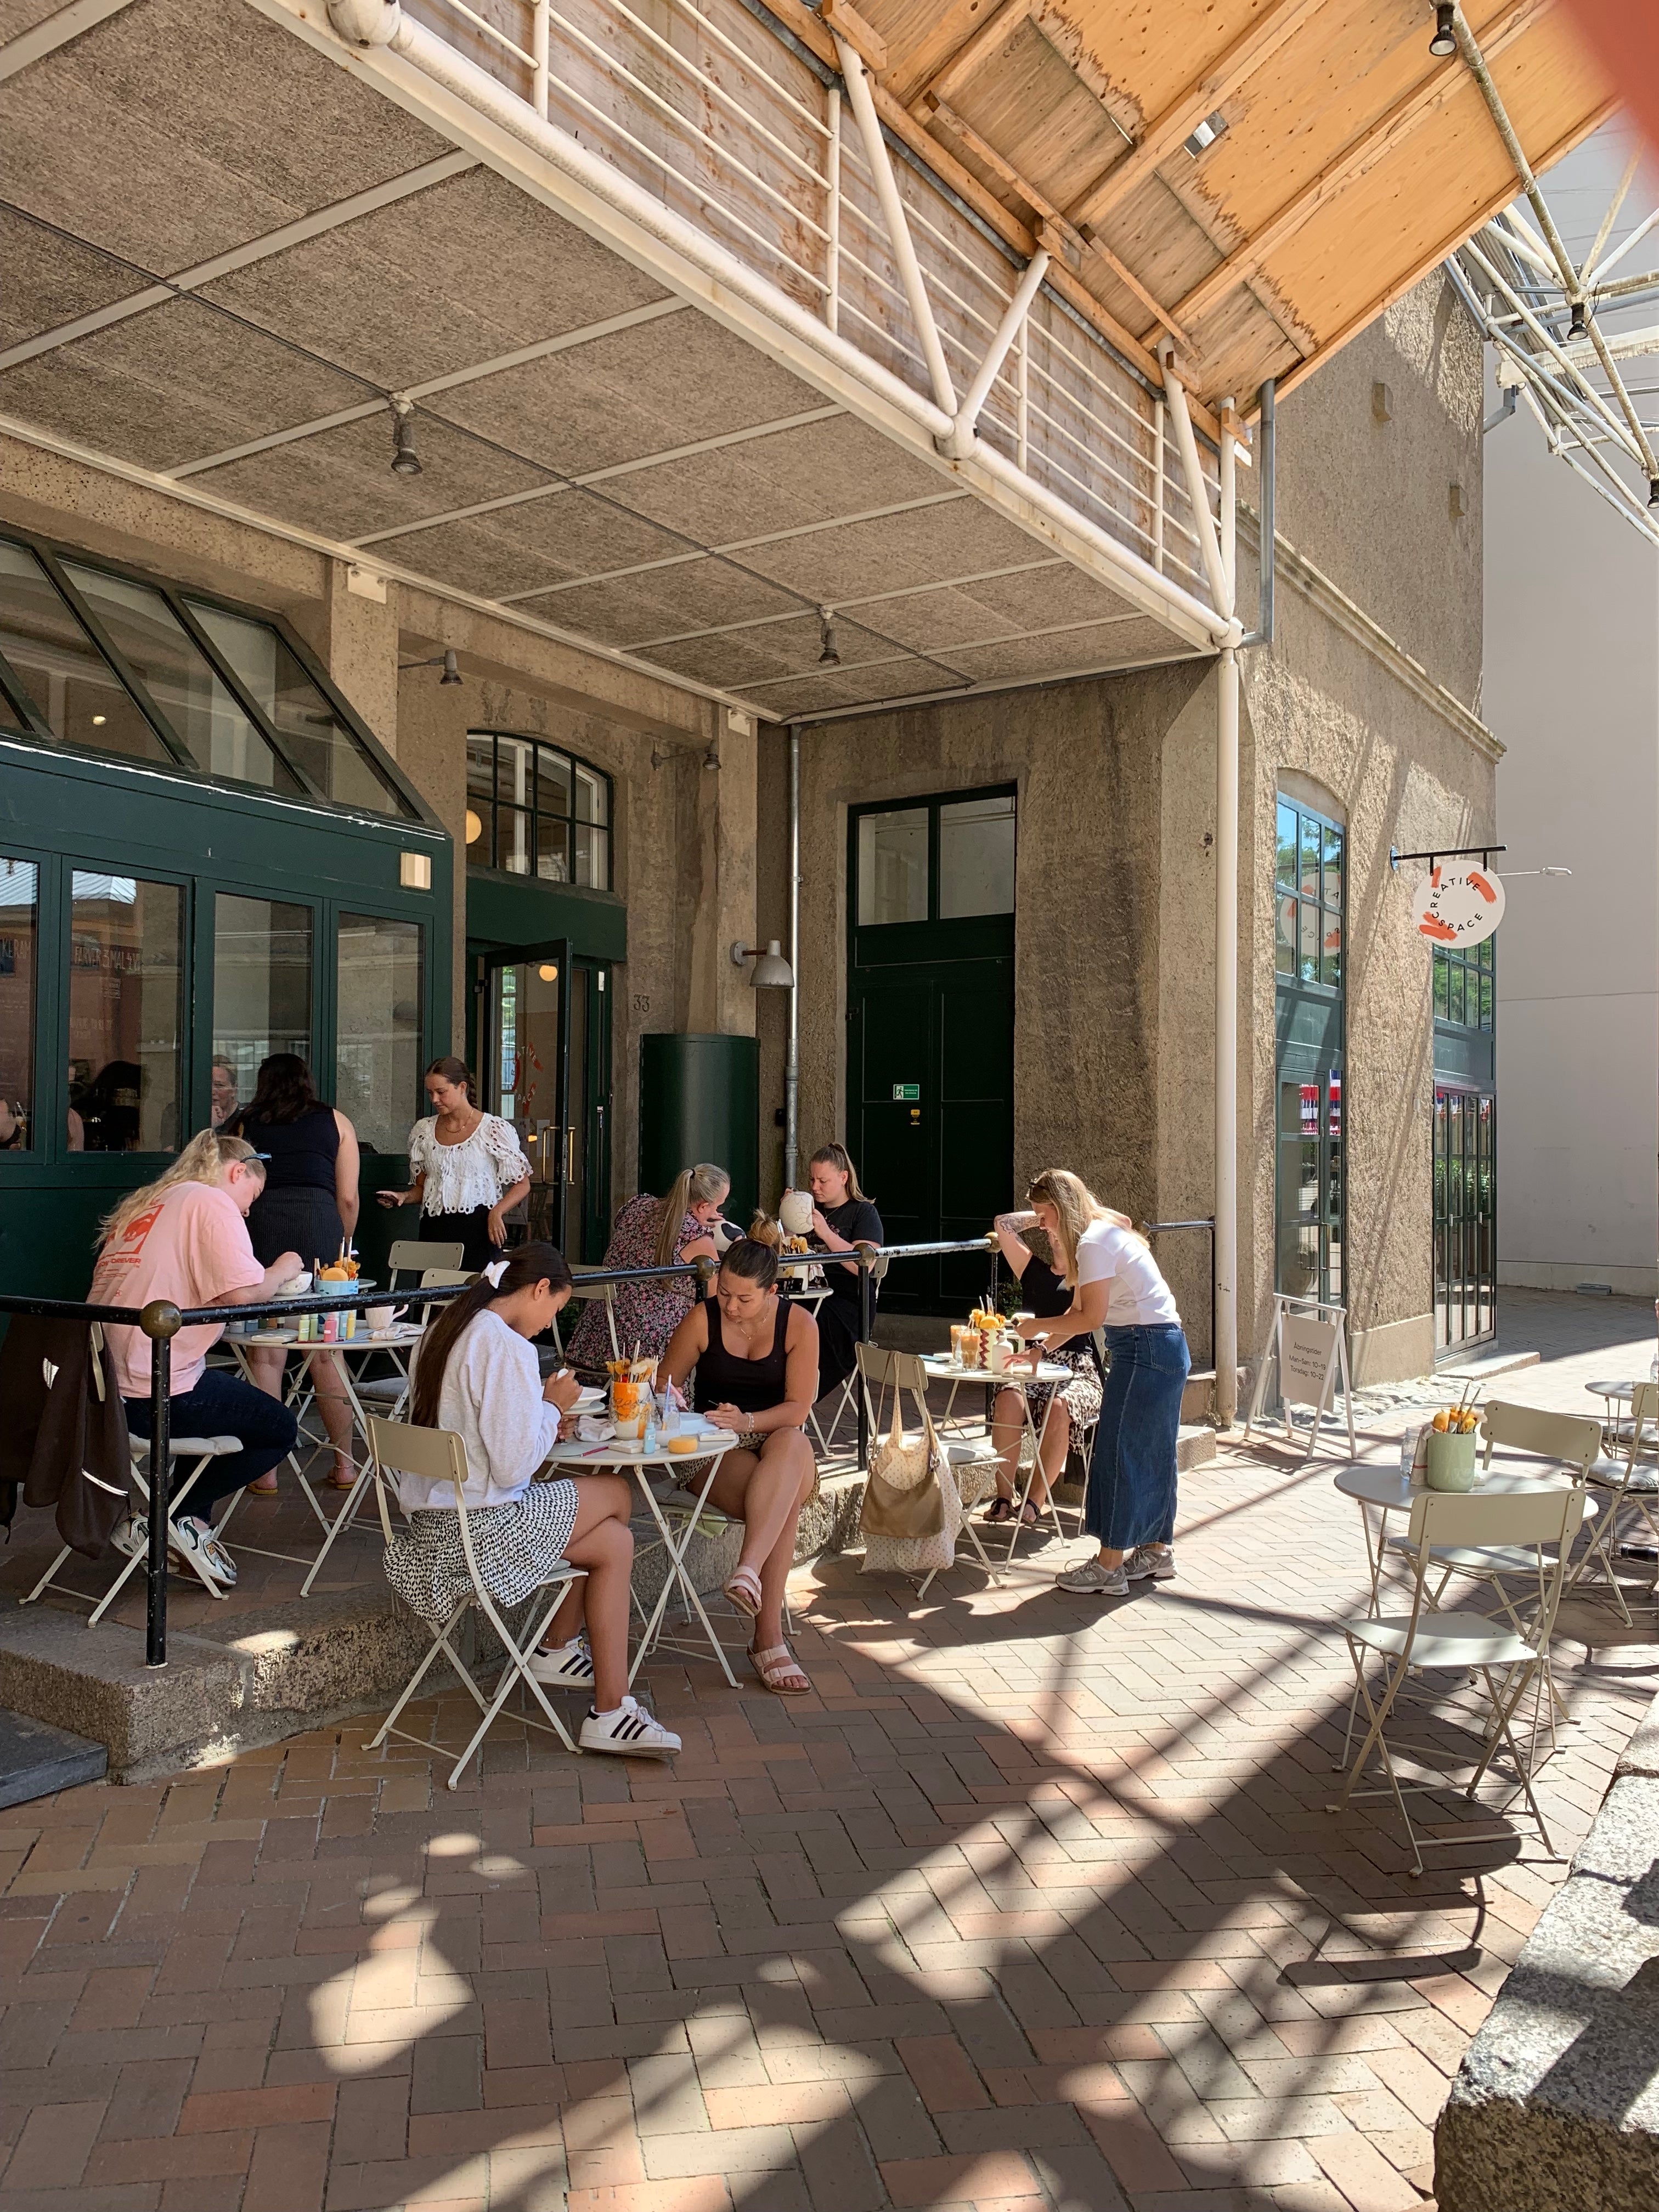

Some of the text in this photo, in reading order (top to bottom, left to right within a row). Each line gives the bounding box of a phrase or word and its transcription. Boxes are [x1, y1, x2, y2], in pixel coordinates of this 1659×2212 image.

[1430, 877, 1480, 918] CREATIVE
[1438, 913, 1482, 932] SPACE
[634, 994, 650, 1012] 33
